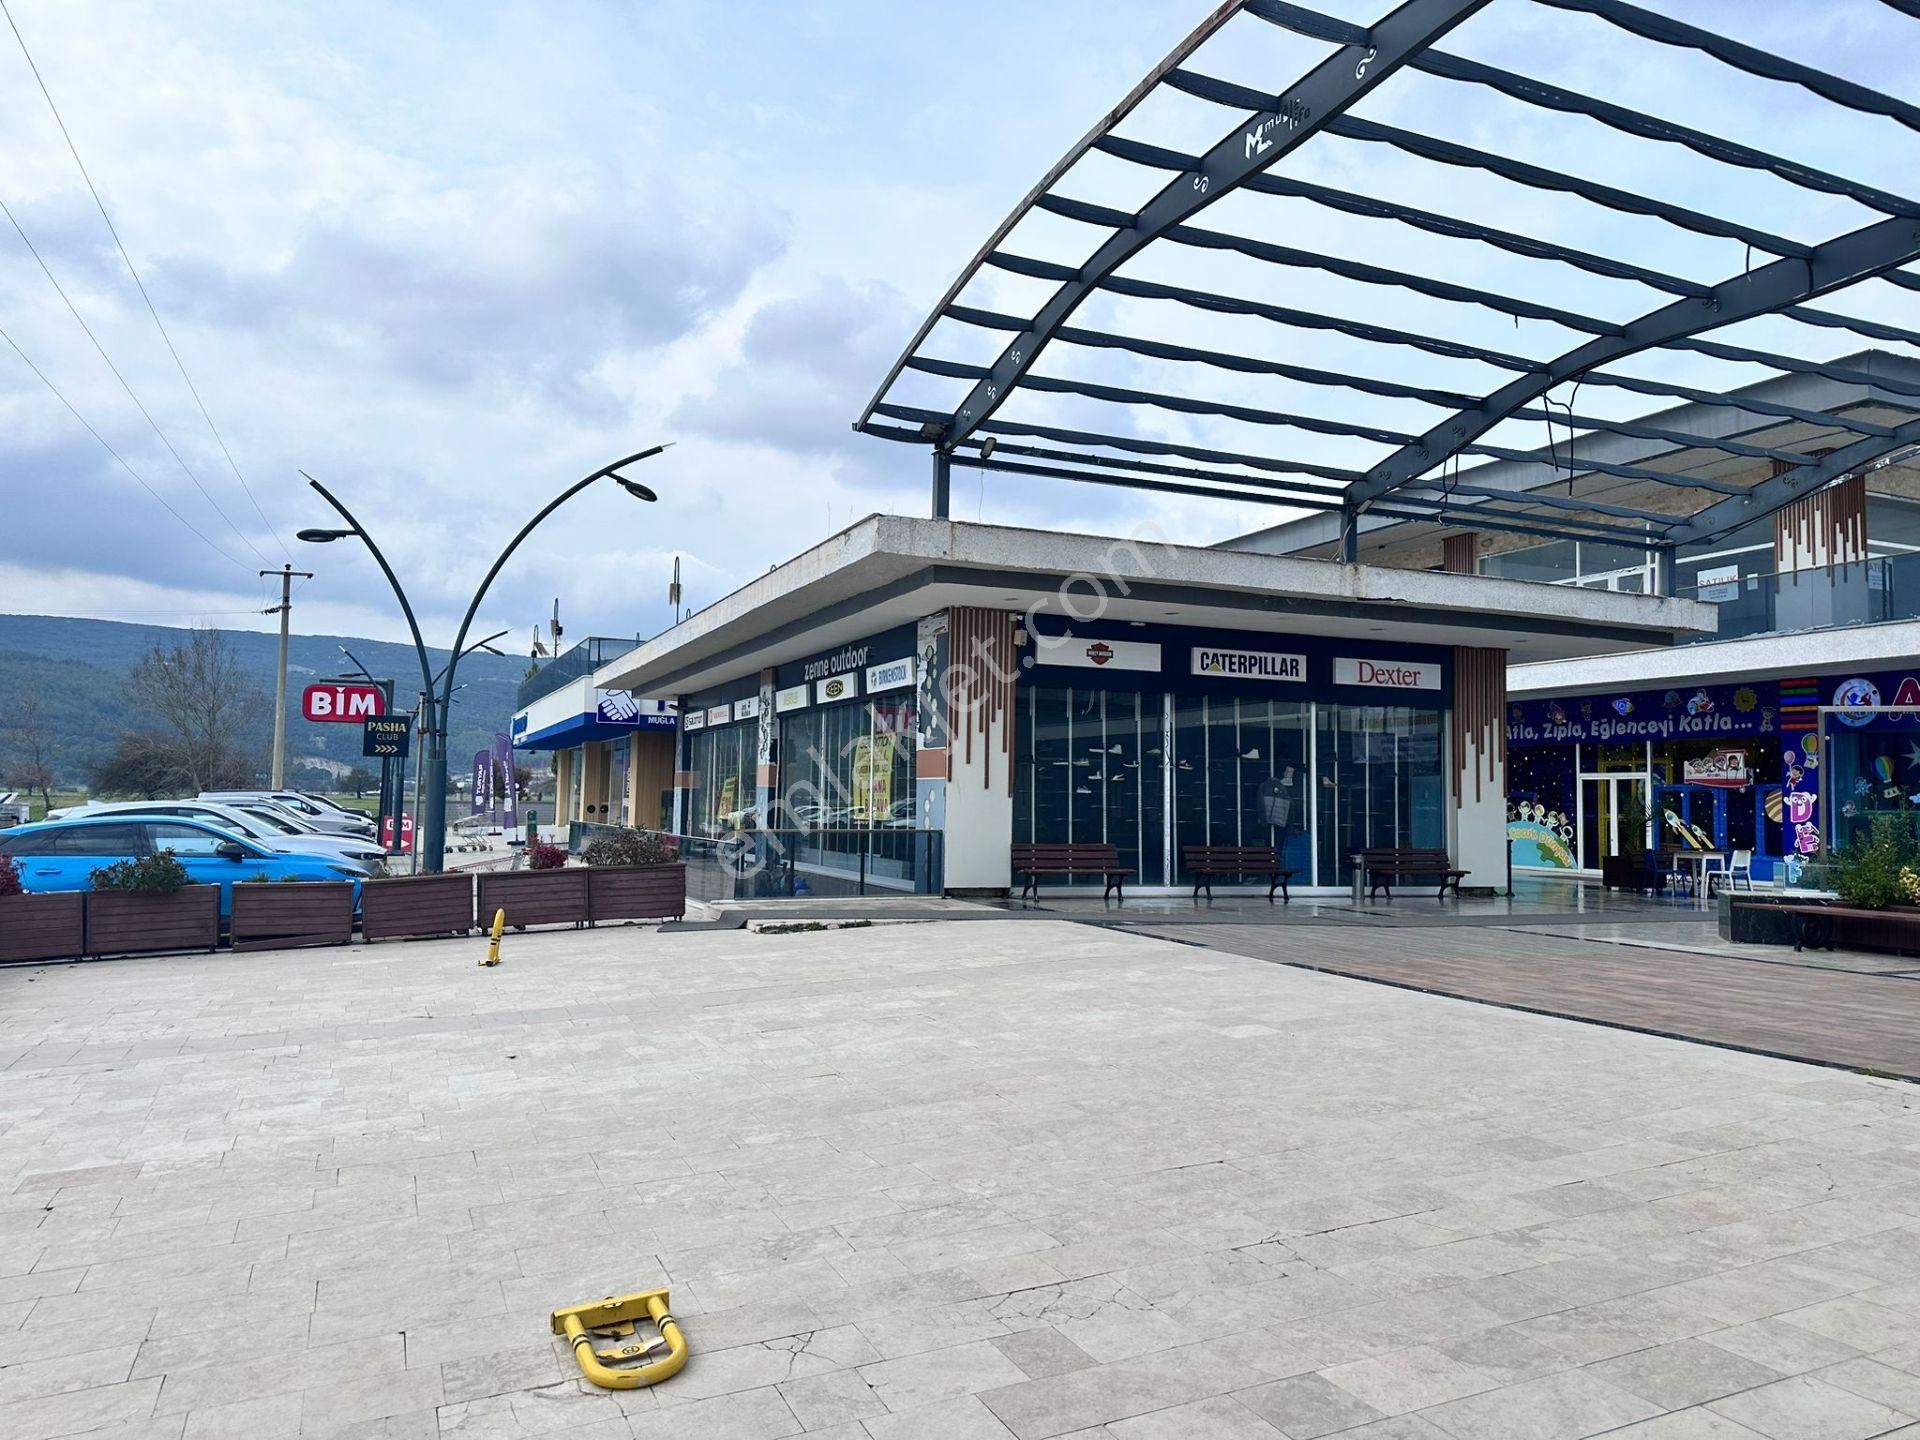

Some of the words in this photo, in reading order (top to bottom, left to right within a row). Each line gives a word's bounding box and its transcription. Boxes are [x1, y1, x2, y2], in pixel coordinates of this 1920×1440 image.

[804, 662, 829, 681] zenne
[830, 645, 869, 674] outdoor
[1200, 652, 1300, 677] CATERPILLAR
[1357, 661, 1421, 686] Dexter
[367, 721, 407, 734] PASHA
[376, 732, 400, 742] CLUB
[1506, 724, 1538, 741] Atla,
[1542, 721, 1587, 742] Zıpla,
[1590, 714, 1674, 740] Eğlenceyi
[1679, 712, 1752, 734] Katla...
